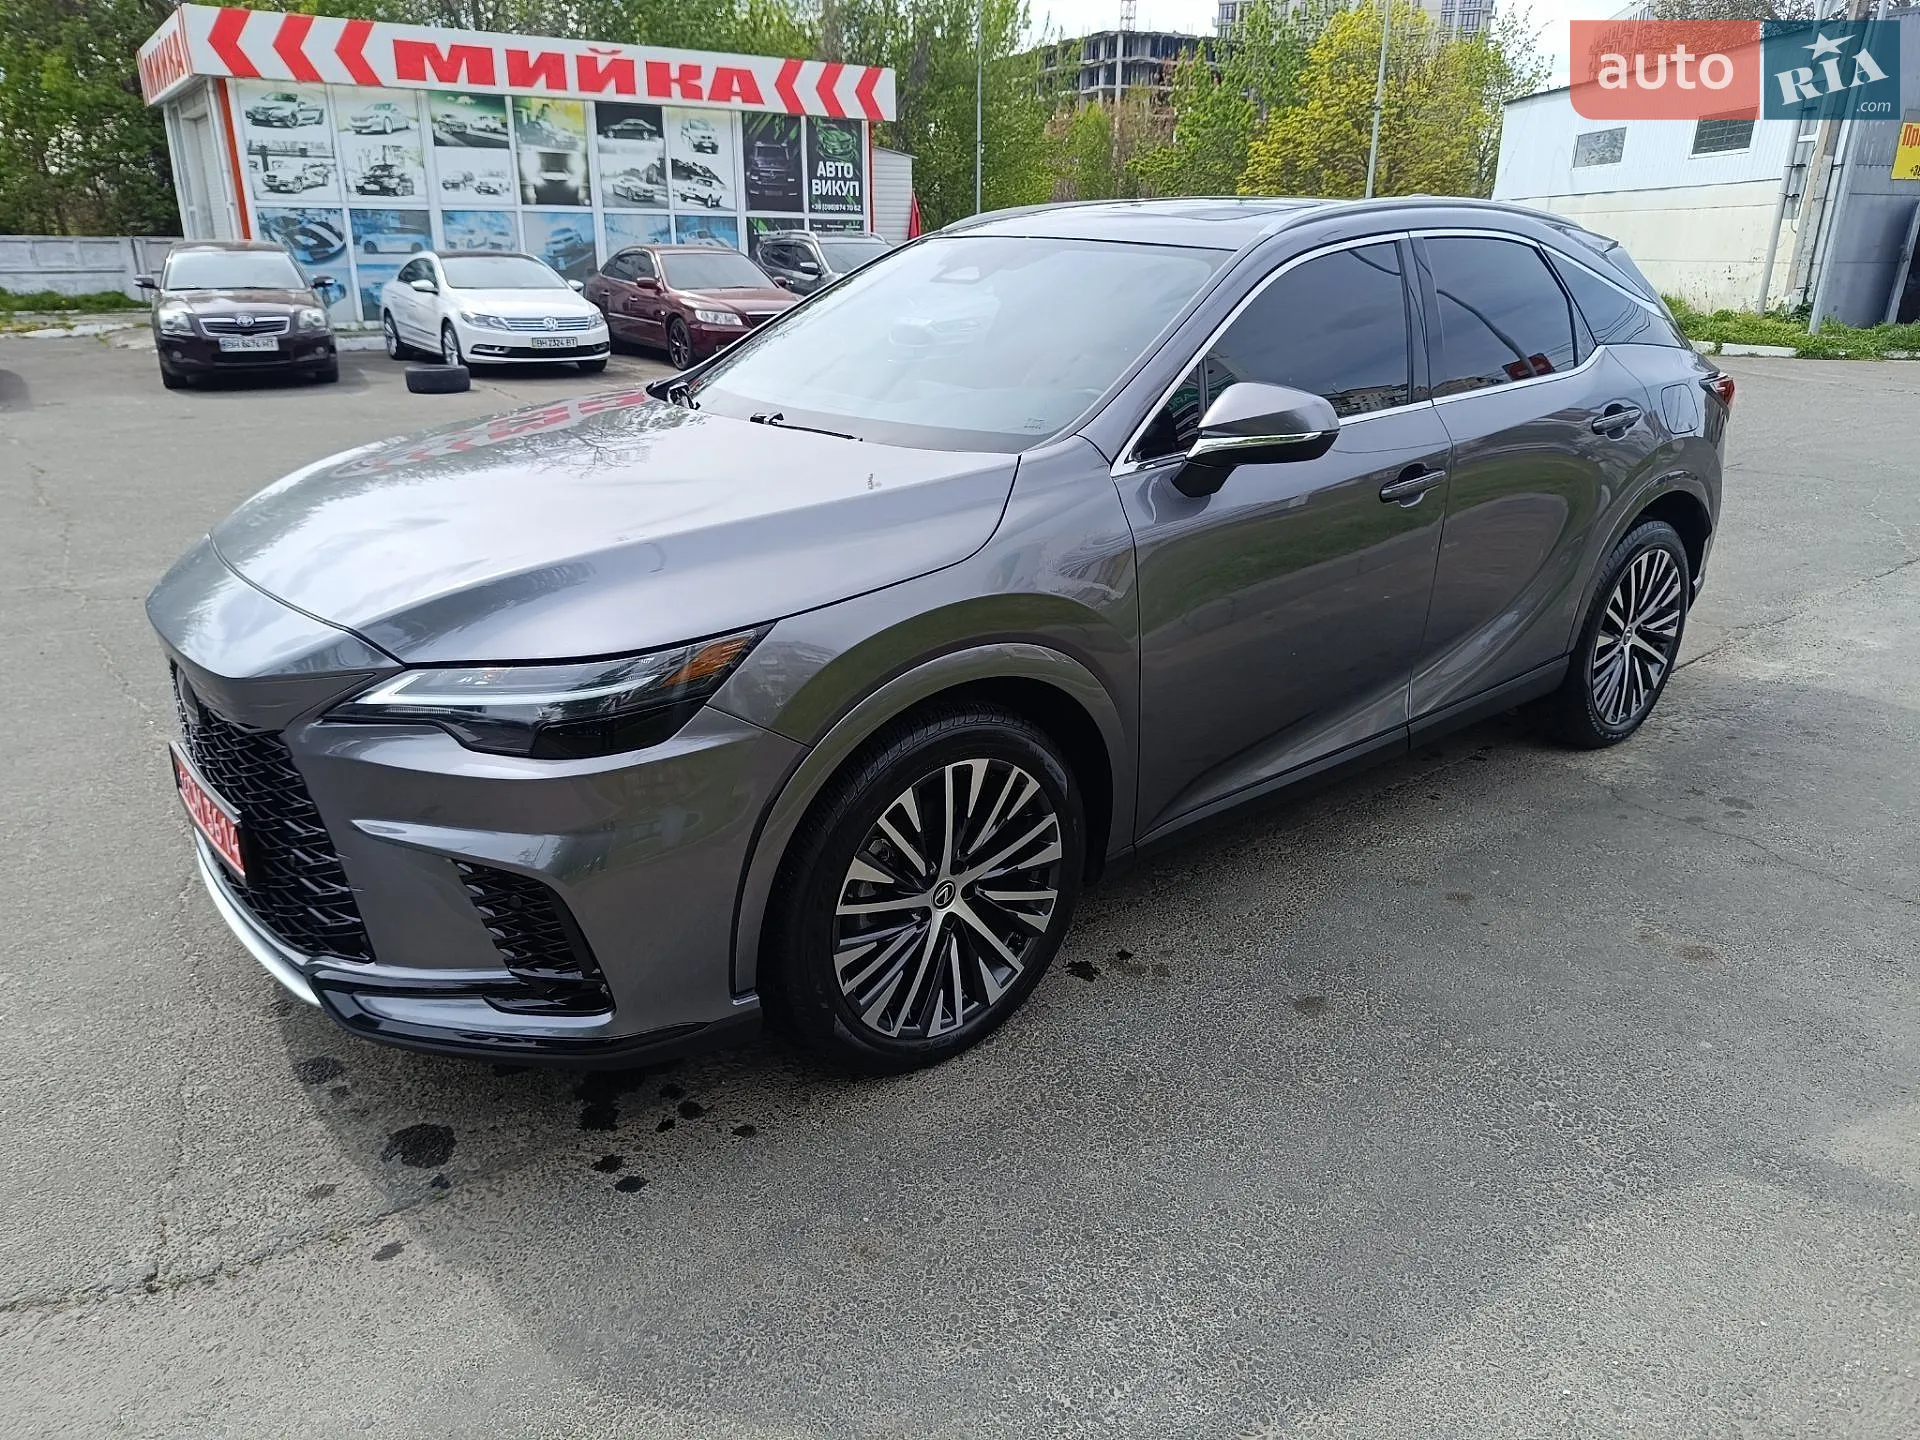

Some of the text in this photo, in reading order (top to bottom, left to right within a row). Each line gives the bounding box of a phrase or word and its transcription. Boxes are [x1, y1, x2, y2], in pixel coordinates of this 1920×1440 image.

[392, 39, 765, 105] МИЙКА
[817, 161, 853, 178] АВТО
[811, 179, 859, 197] ВИКУП
